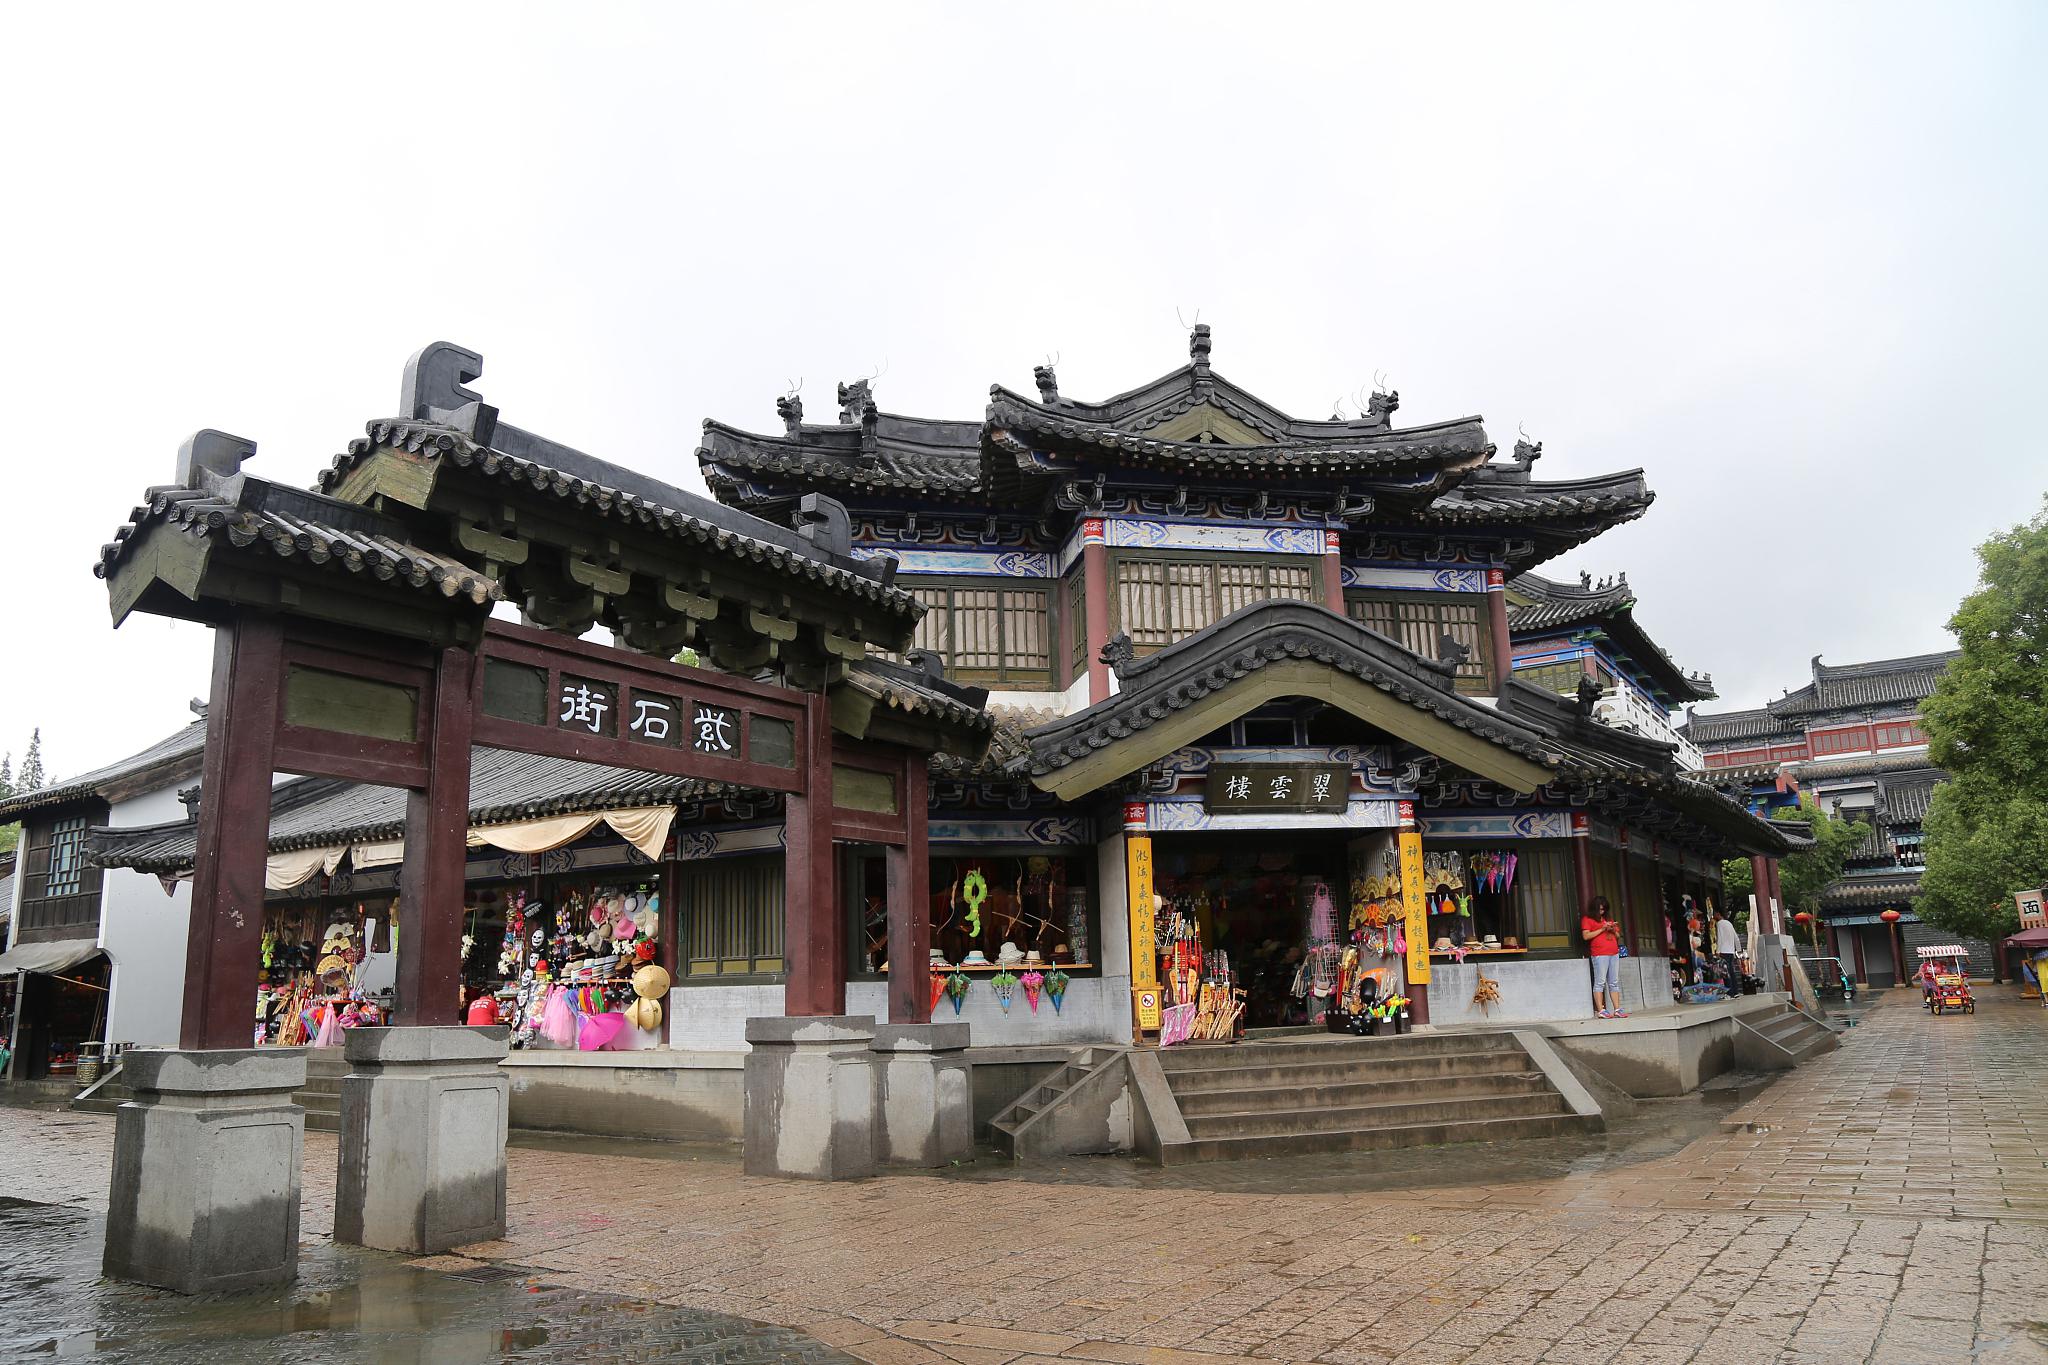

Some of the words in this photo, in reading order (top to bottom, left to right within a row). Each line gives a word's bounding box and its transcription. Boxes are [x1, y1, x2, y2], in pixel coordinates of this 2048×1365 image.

[560, 684, 732, 752] 紫石街
[1225, 773, 1332, 802] 翠雲樓
